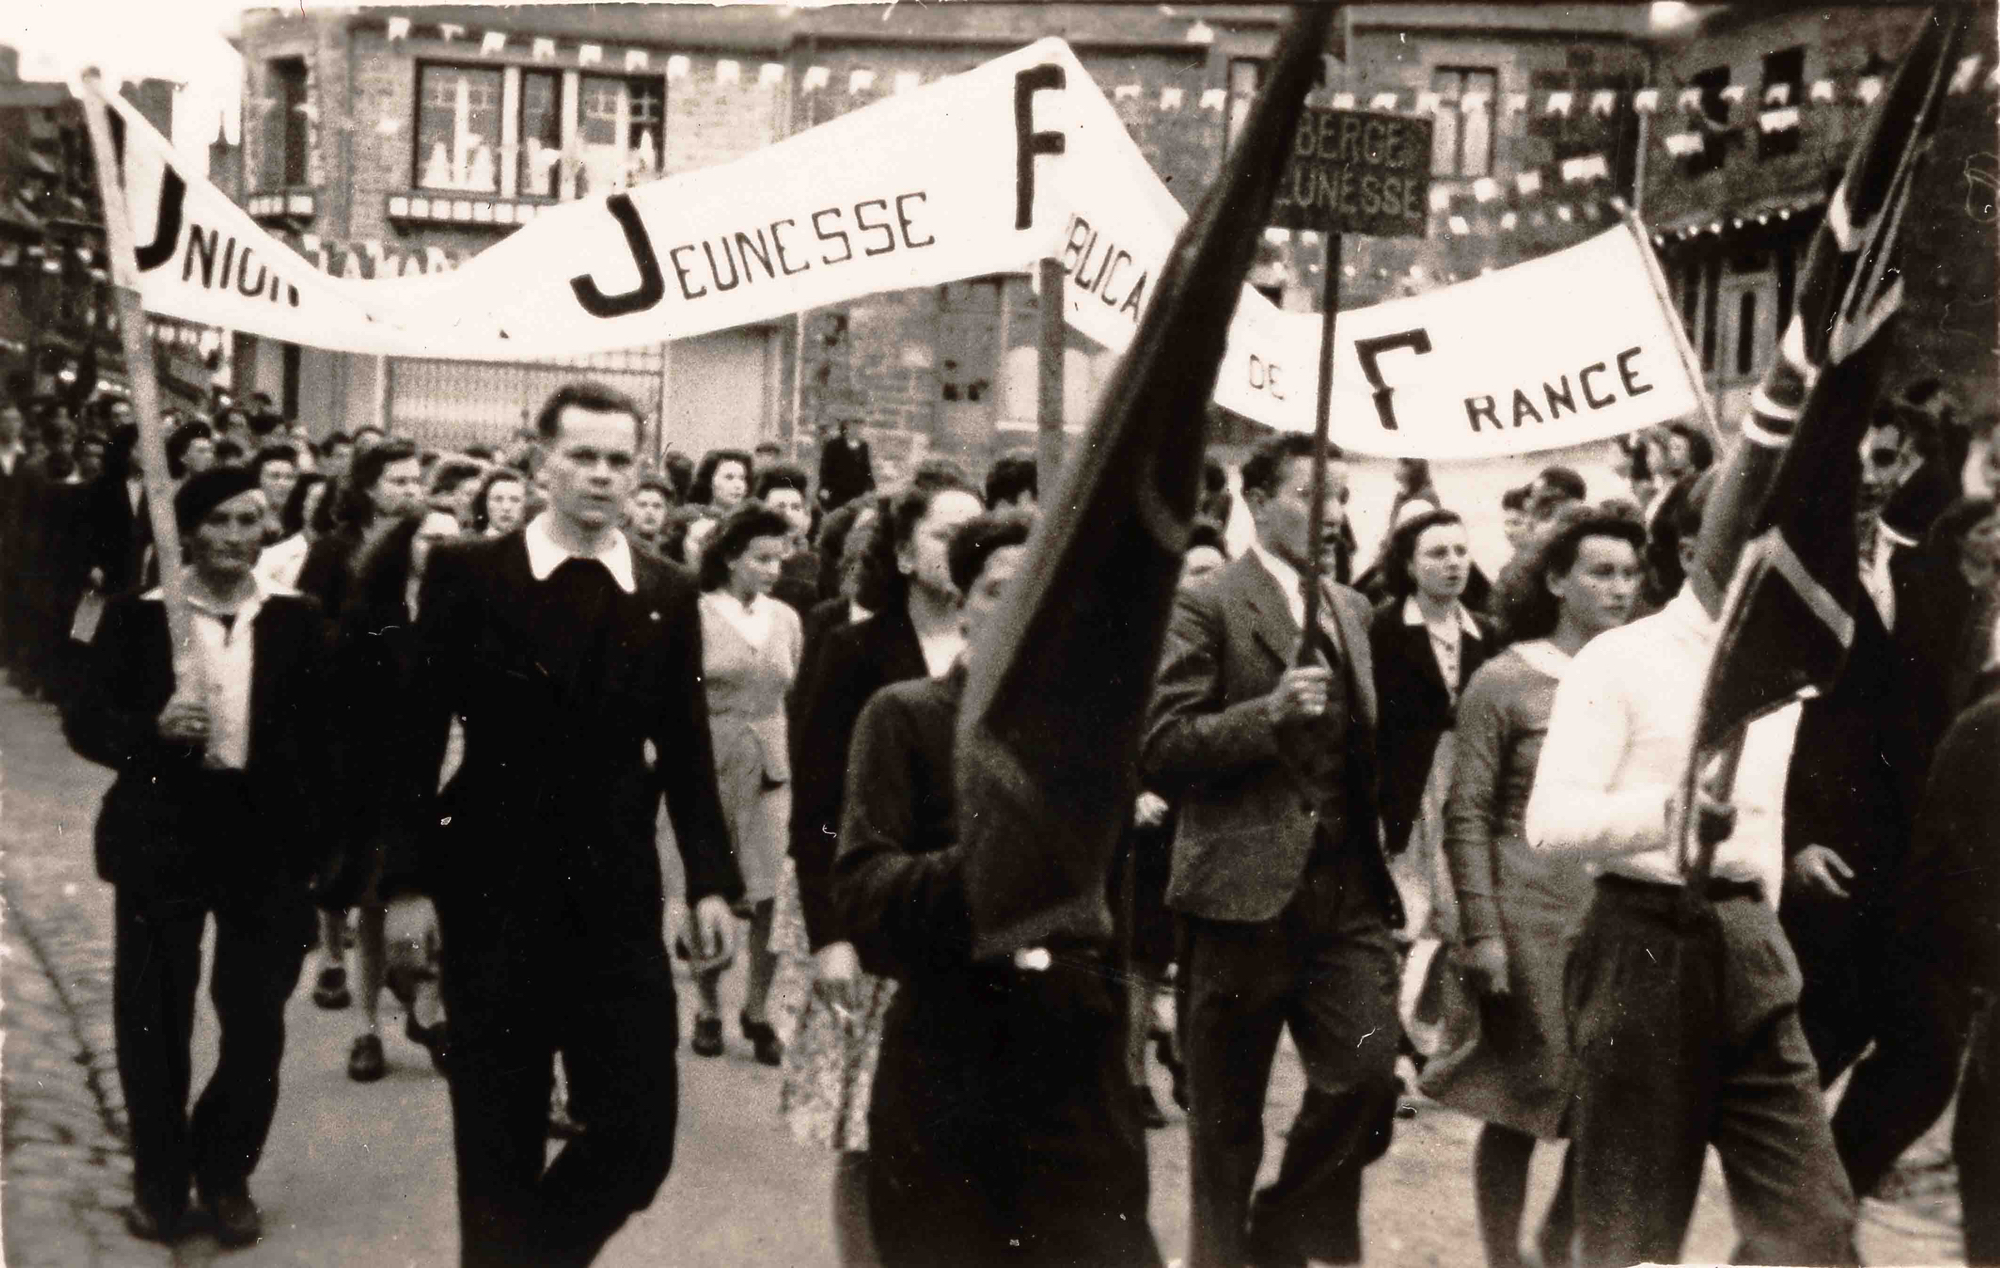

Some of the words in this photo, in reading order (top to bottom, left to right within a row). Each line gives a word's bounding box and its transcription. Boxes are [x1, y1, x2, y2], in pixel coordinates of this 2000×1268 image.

[1294, 113, 1406, 168] BERGE
[570, 192, 936, 319] JEUNESSE
[1062, 213, 1148, 323] BLICA
[1248, 354, 1285, 400] DE
